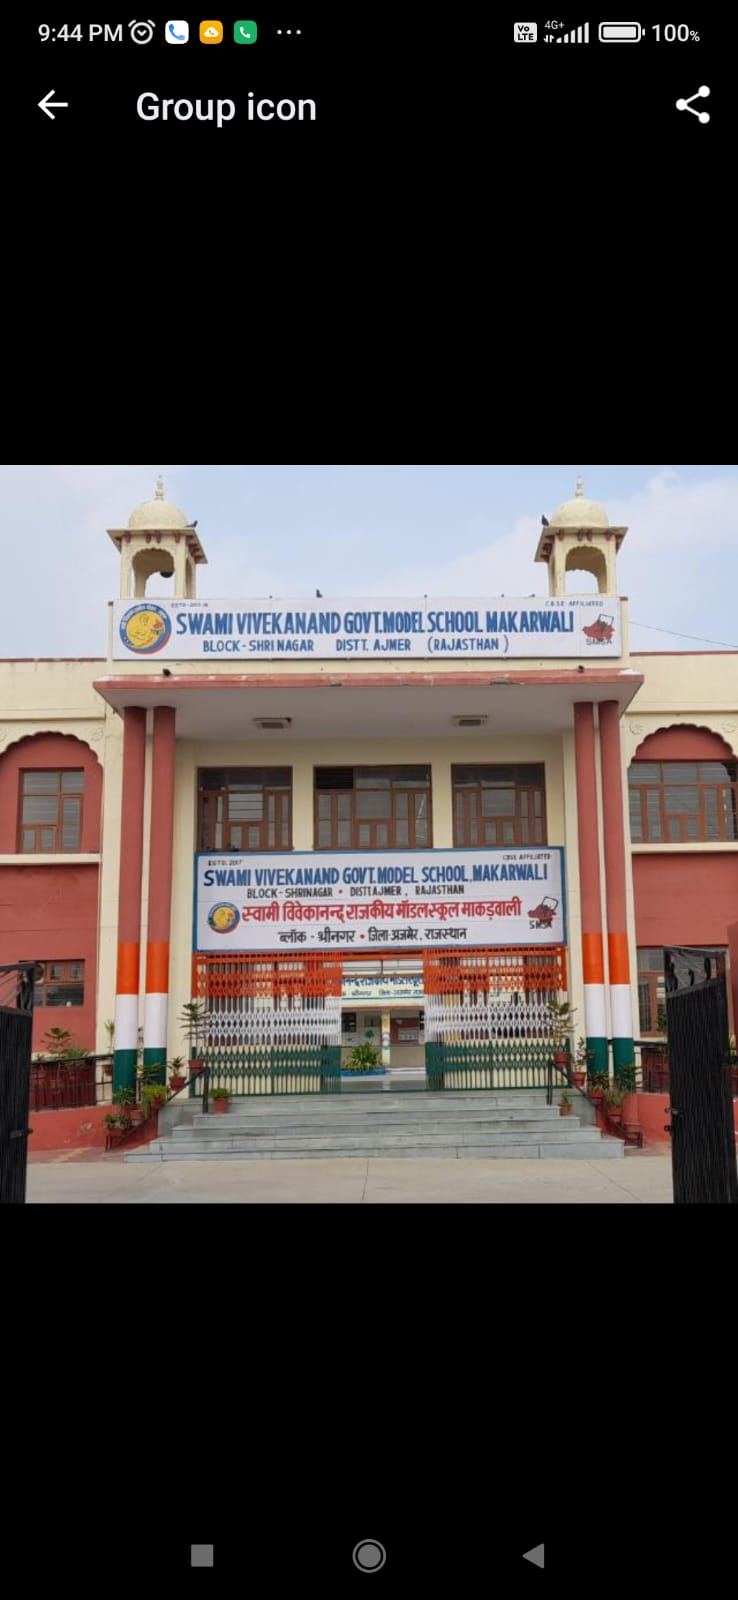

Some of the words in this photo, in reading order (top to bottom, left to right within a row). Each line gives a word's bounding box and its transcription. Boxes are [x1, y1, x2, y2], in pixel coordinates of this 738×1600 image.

[176, 612, 232, 635] SWAMI
[237, 612, 341, 635] VIVEKANAND
[427, 610, 483, 633] SCHOOL
[486, 610, 574, 633] MAKARWALI
[373, 639, 411, 651] AJMER
[203, 869, 251, 887] SWAMI
[255, 867, 340, 886] VIVEKANAND
[473, 863, 548, 881] MAKARWALI
[415, 884, 465, 895] RAJASTHAN
[242, 901, 280, 922] स्वामी
[346, 899, 394, 922] राजकीय
[461, 896, 522, 920] माकड़वाली
[278, 929, 307, 943] ब्लॉक
[317, 926, 356, 943] श्रीनगर
[424, 927, 467, 940] राजस्थान
